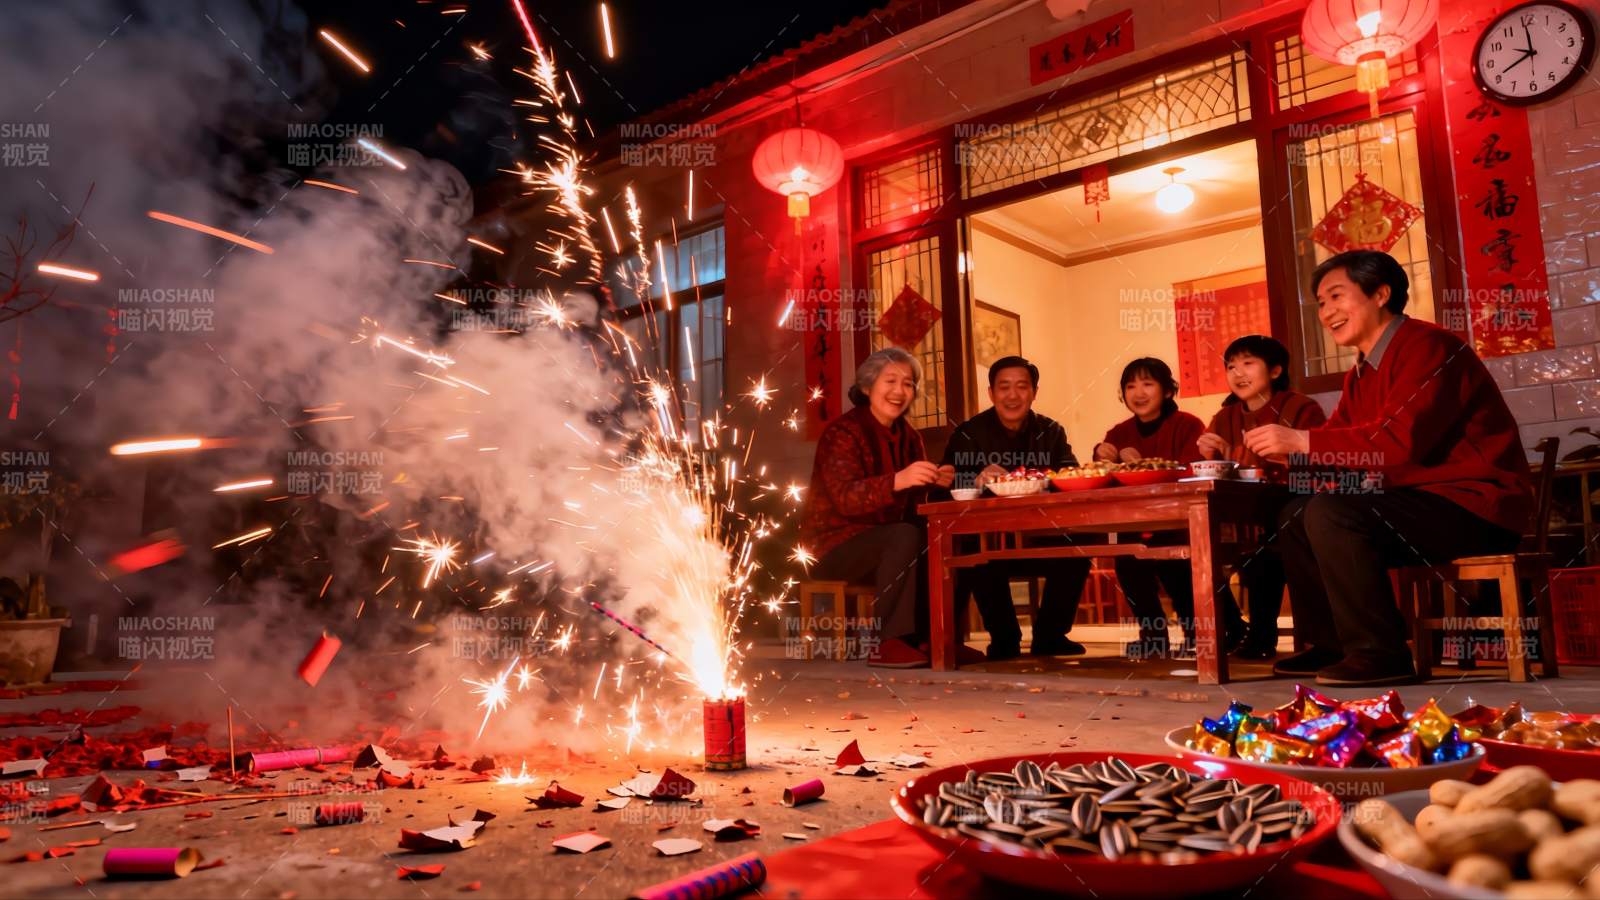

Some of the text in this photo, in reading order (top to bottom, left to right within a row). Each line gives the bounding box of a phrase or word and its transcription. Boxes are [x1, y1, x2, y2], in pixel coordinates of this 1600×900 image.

[1504, 26, 1513, 38] 11
[1491, 42, 1503, 52] 10
[1567, 37, 1575, 47] 3
[1529, 80, 1538, 92] 6
